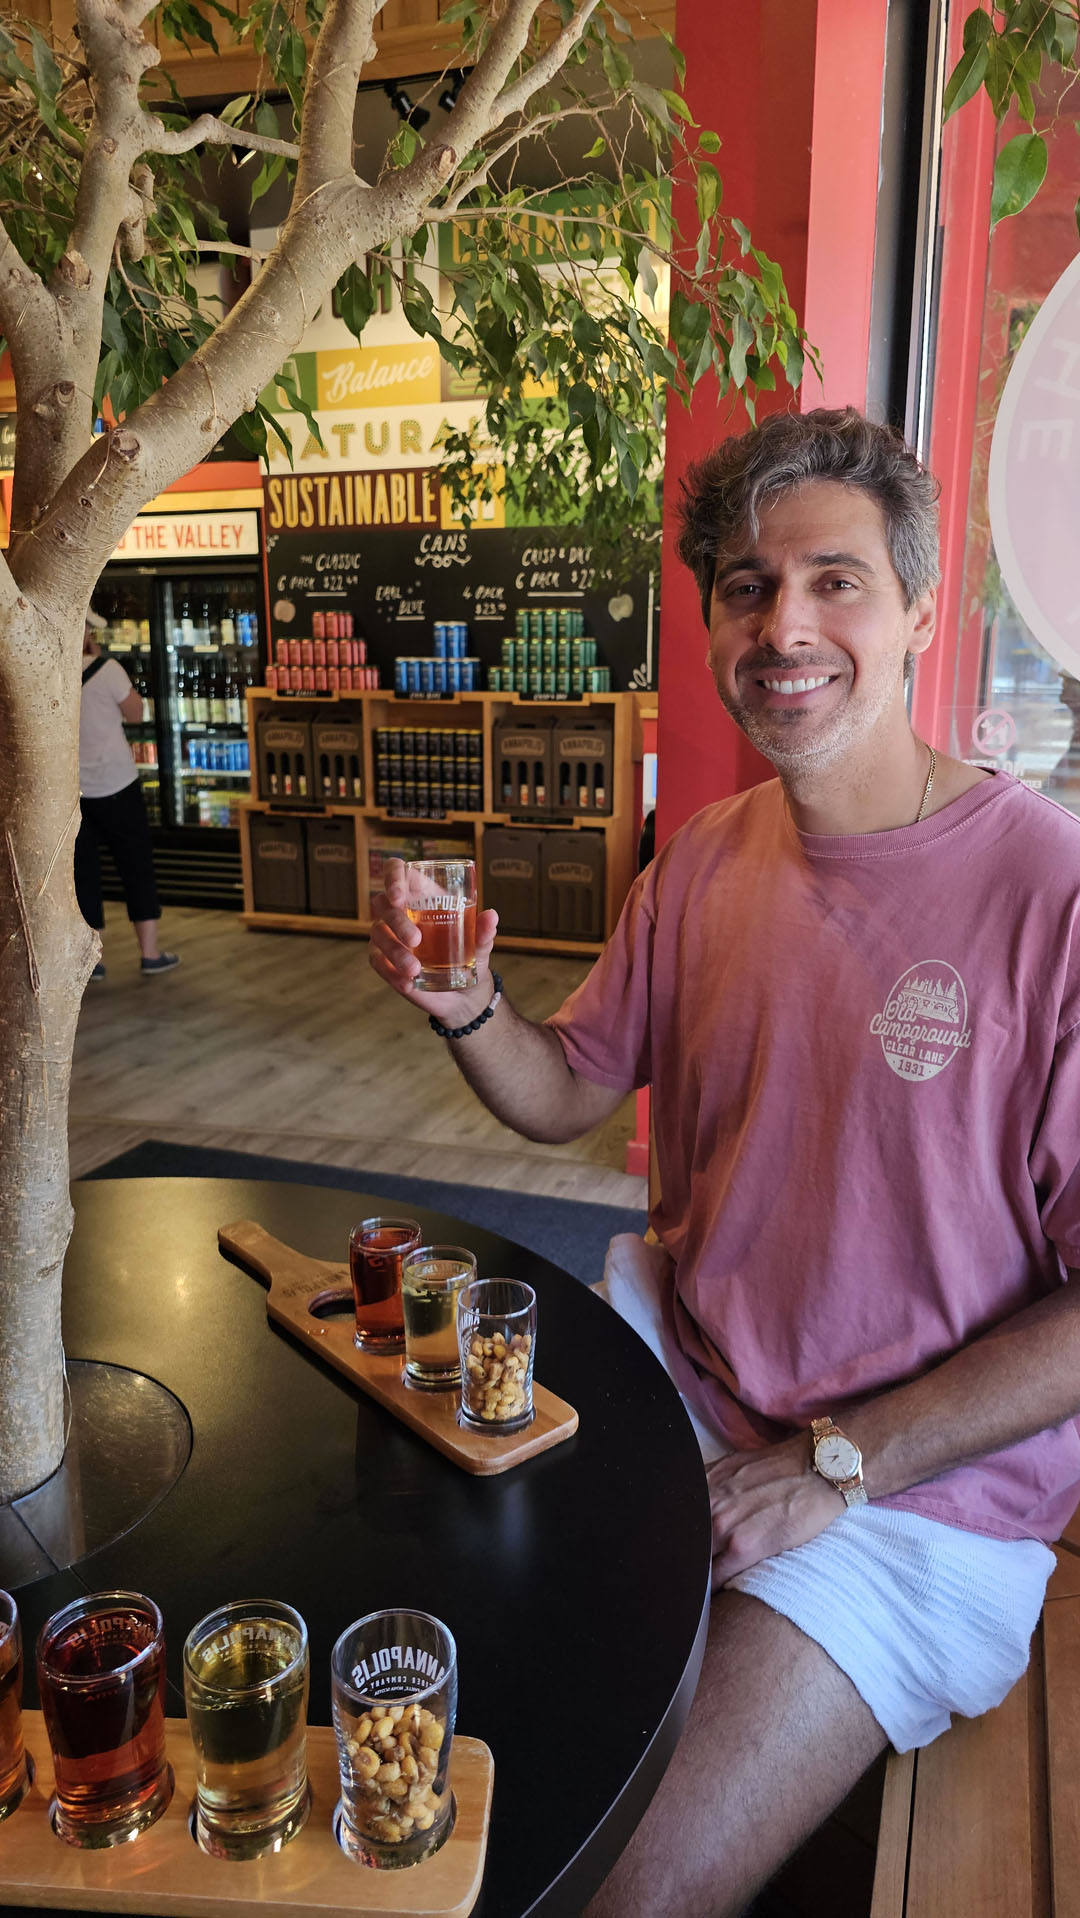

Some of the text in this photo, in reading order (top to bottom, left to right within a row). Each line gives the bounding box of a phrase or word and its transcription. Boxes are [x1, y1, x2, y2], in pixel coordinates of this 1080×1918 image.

[322, 355, 434, 403] Balance
[267, 416, 497, 461] NATURAL
[268, 472, 437, 529] SUSTAINABLE
[132, 525, 167, 549] THE
[174, 524, 243, 549] VALLEY
[420, 534, 468, 553] CANS
[315, 553, 361, 571] CLASSIC
[522, 548, 556, 567] CRISP
[568, 546, 593, 564] DRY
[277, 575, 287, 591] 6
[289, 576, 315, 590] PACK
[515, 572, 525, 589] 6
[530, 571, 560, 588] PACK
[462, 585, 504, 600] 4 PACK
[399, 600, 425, 615] BLUE
[886, 996, 917, 1023] Old
[870, 1013, 972, 1049] Campground
[886, 1040, 915, 1057] CLEAR
[898, 1059, 925, 1077] 1931
